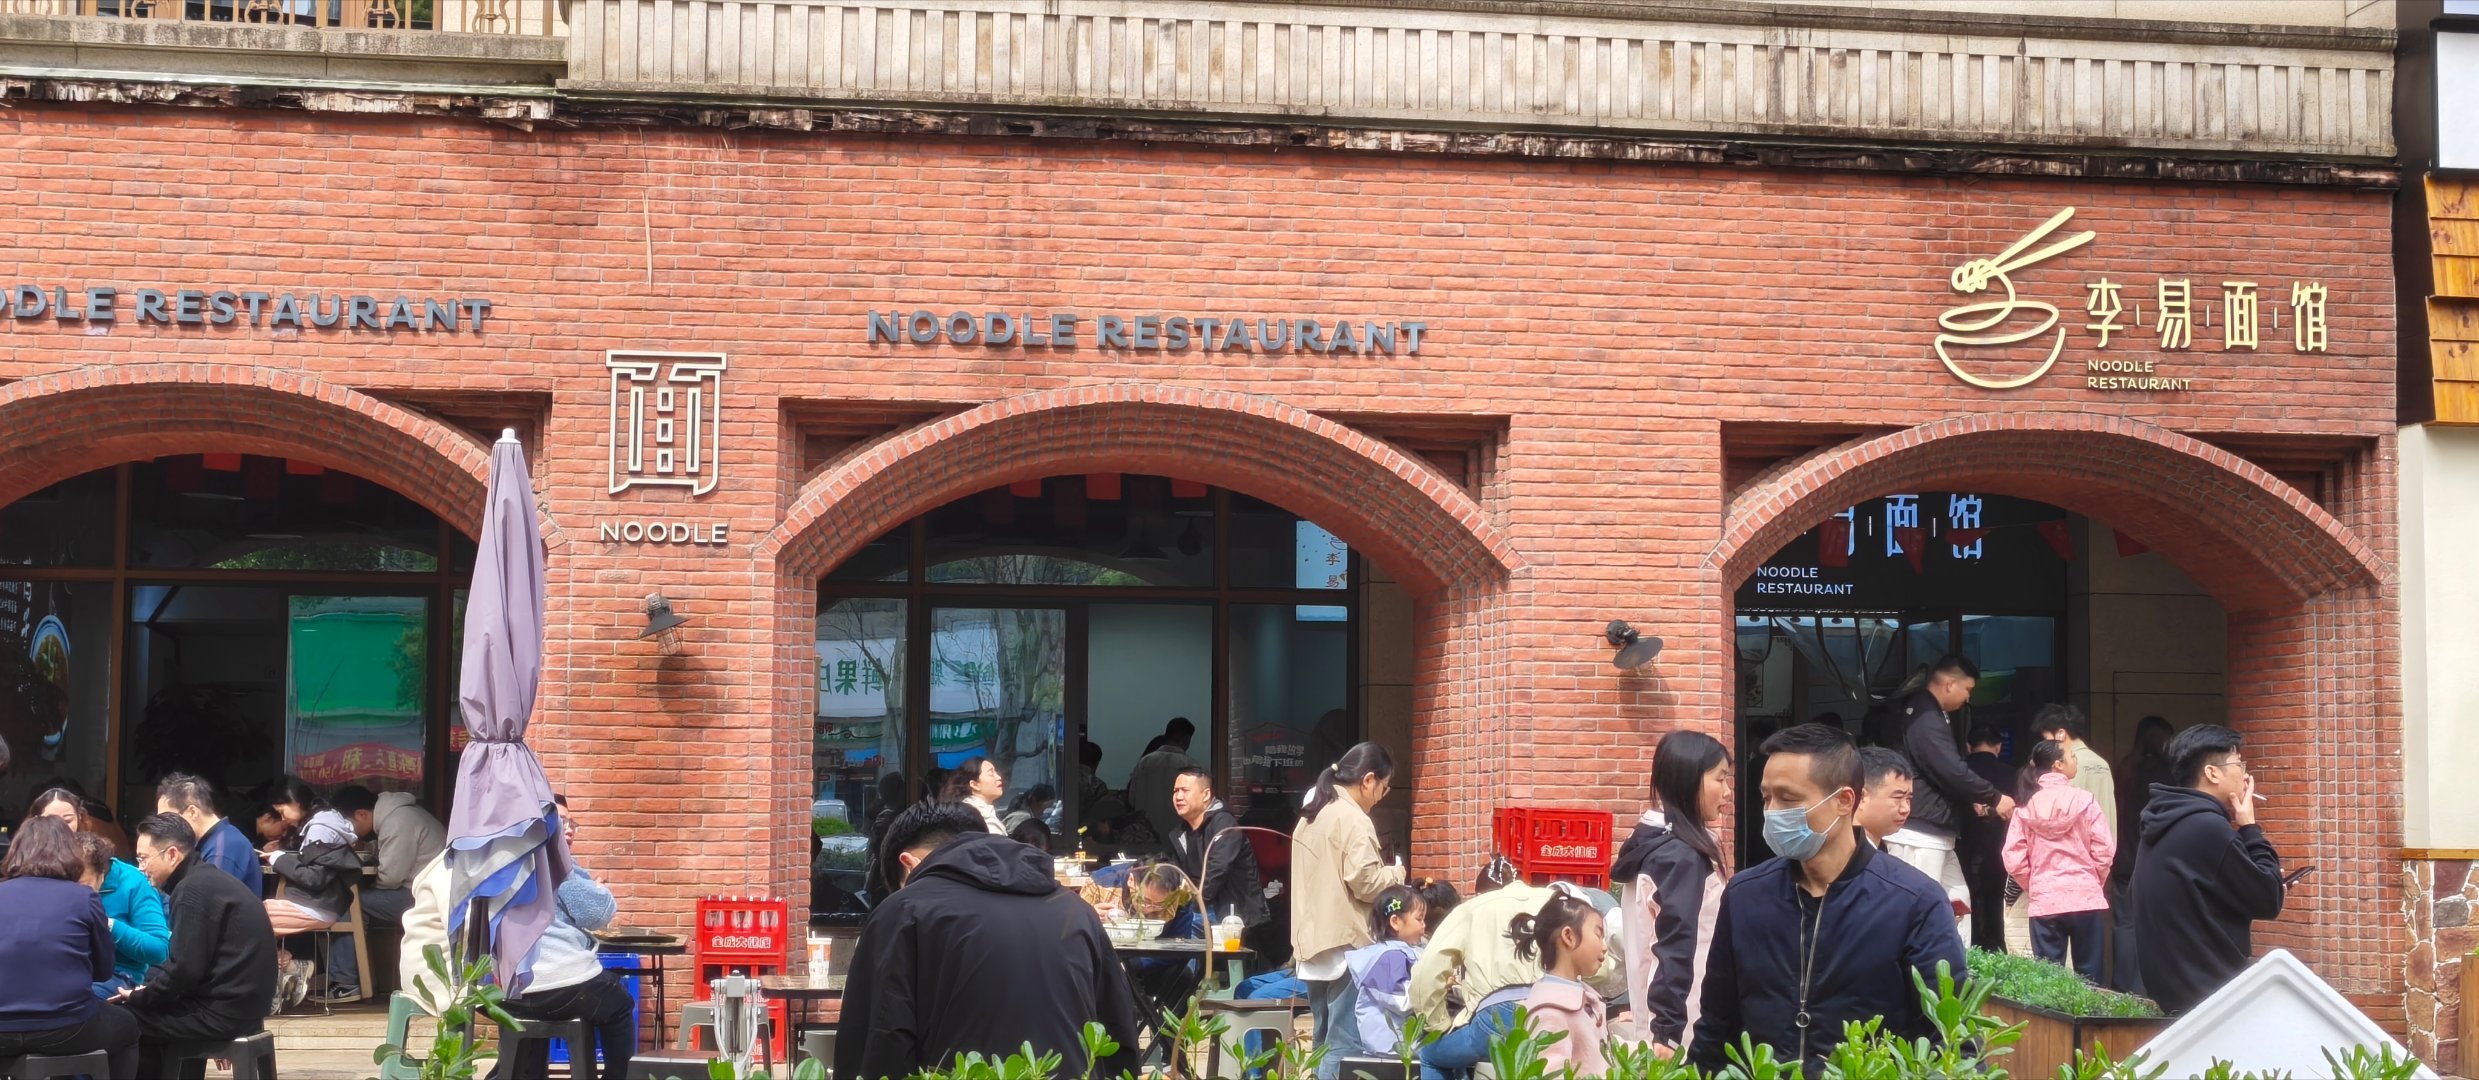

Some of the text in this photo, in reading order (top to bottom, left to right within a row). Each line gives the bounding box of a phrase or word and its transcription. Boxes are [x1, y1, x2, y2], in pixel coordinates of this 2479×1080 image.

[0, 284, 491, 331] DLE RESTAURANT
[2086, 277, 2328, 352] 李易面馆
[868, 310, 1428, 354] NOODLE RESTAURANT
[2087, 359, 2154, 373] NOODLE
[2087, 376, 2192, 391] RESTAURANT
[600, 520, 728, 544] NOODLE
[1756, 566, 1819, 579] NOODLE
[1756, 582, 1854, 596] RESTAURANT
